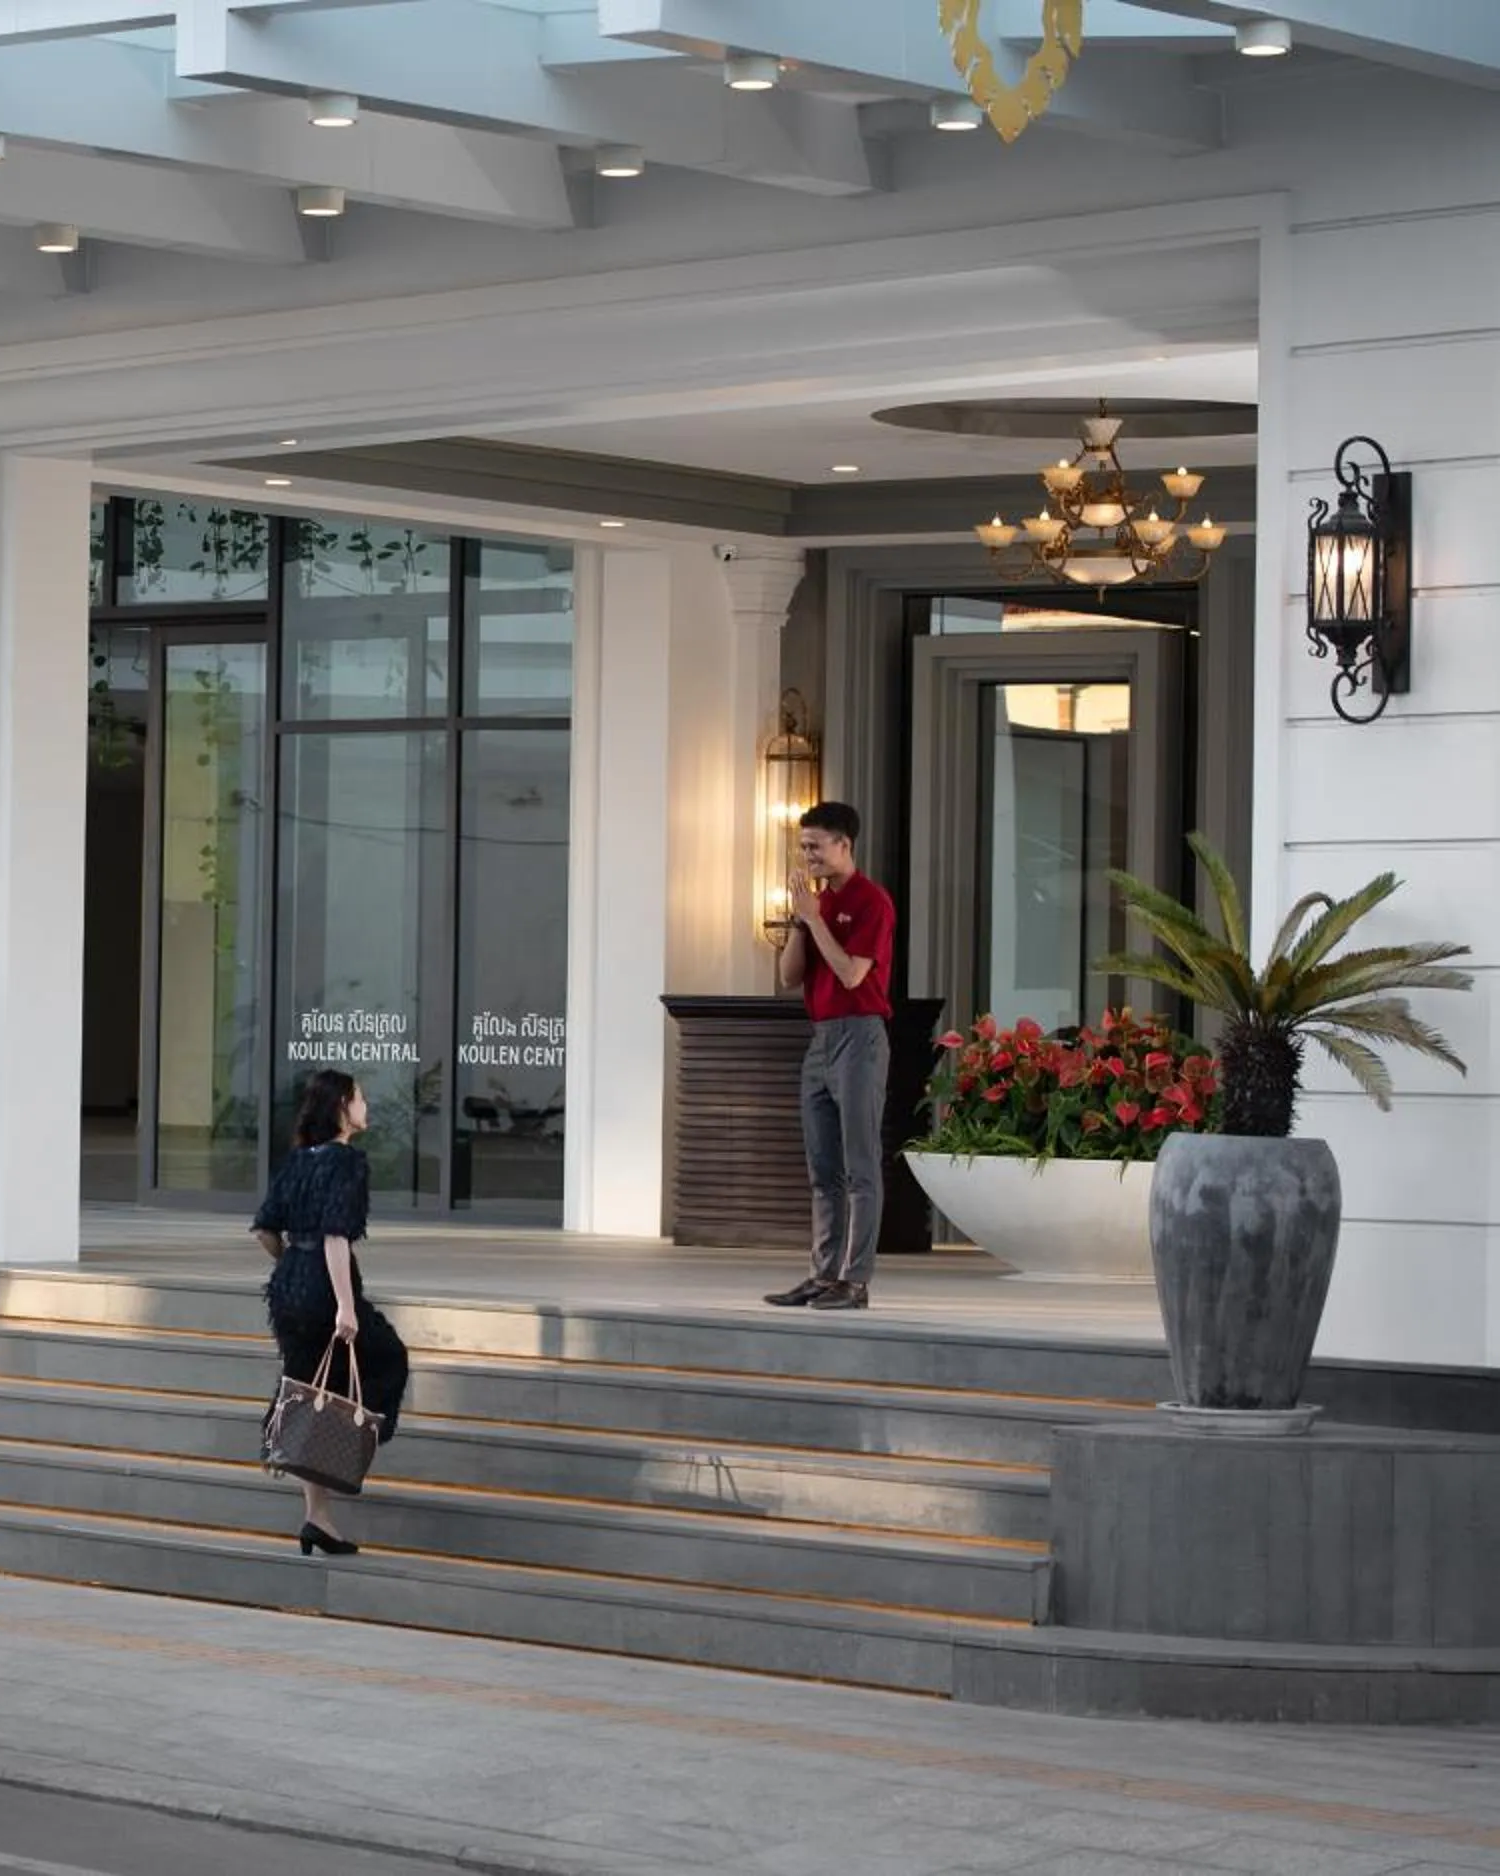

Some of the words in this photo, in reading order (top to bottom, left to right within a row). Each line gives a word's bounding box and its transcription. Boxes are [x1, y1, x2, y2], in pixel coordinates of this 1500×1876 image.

[288, 1041, 347, 1061] KOULEN
[351, 1042, 420, 1063] CENTRAL
[458, 1043, 520, 1065] KOULEN
[523, 1045, 565, 1067] CENT
